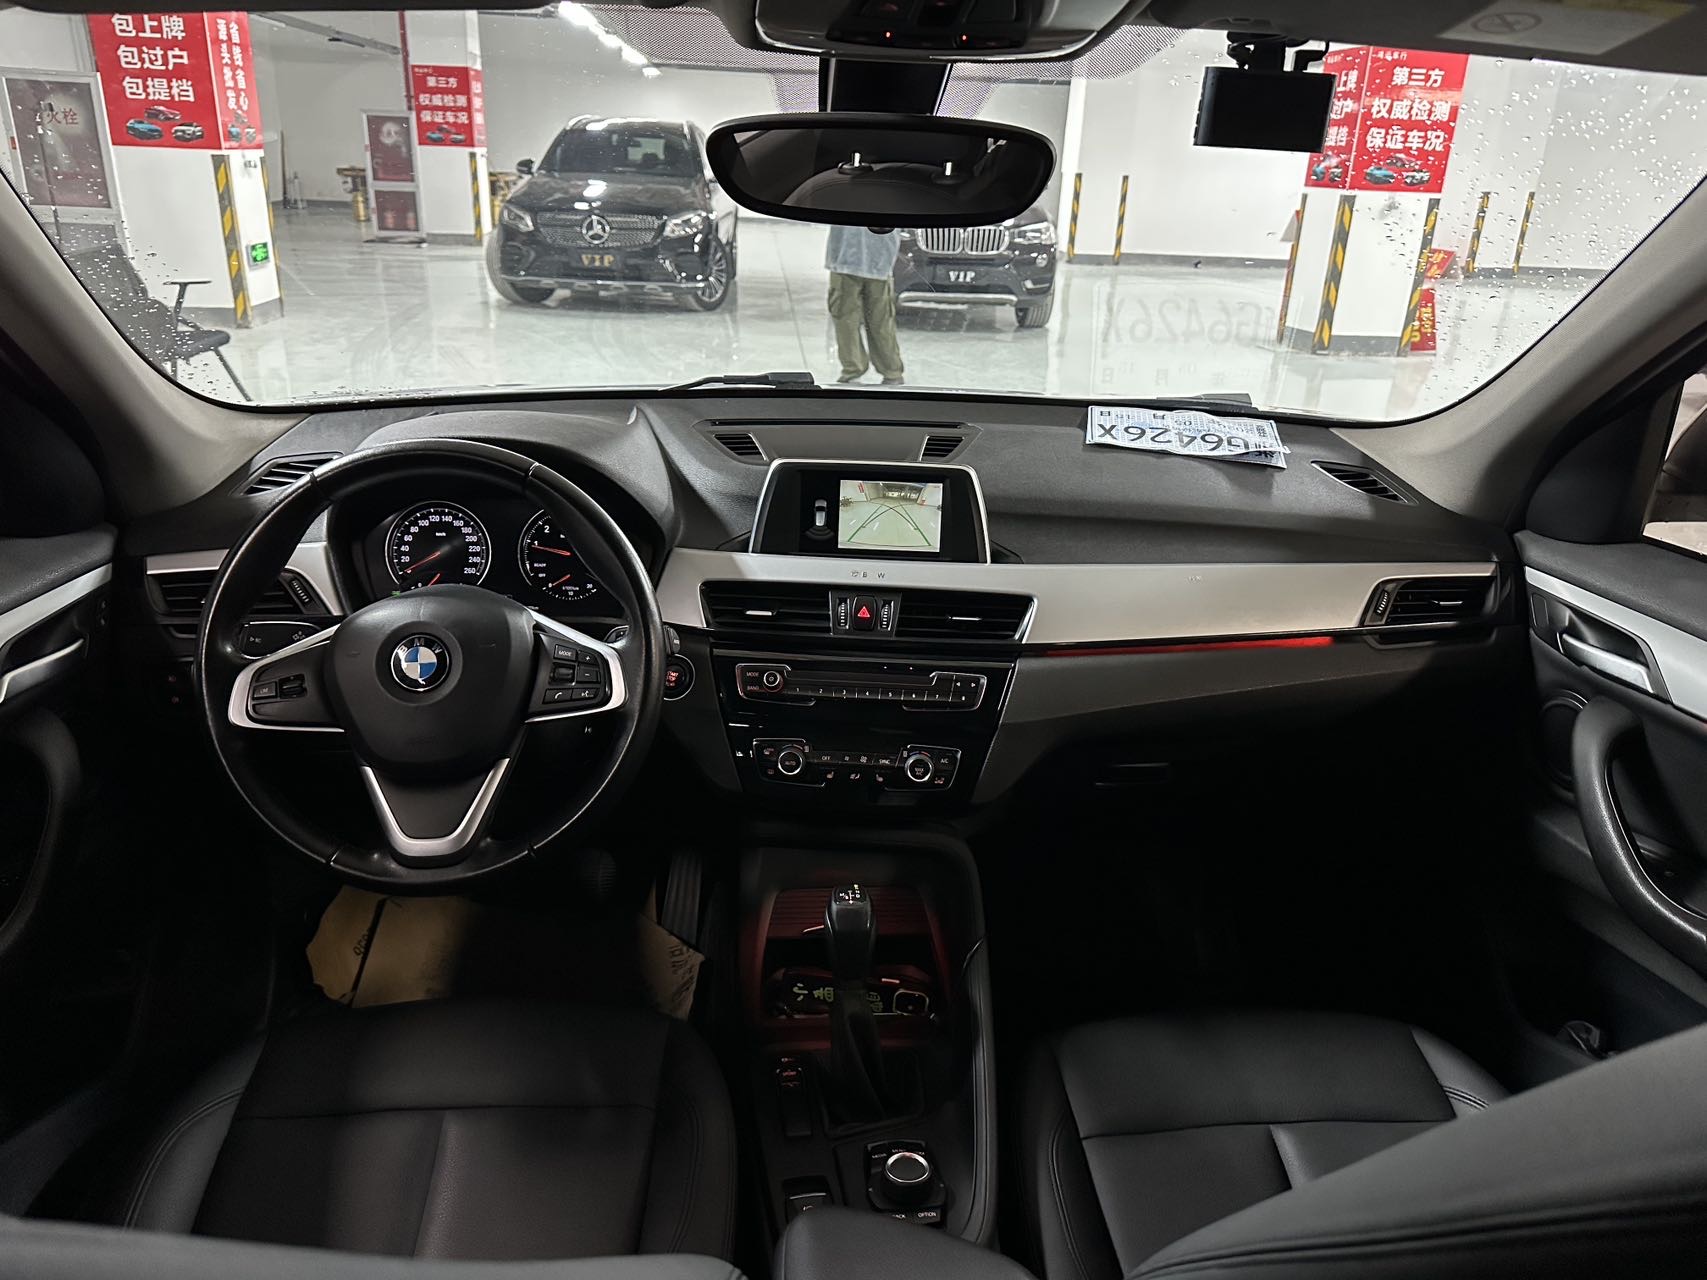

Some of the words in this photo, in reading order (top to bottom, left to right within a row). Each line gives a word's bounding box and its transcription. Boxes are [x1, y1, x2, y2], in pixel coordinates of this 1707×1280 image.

[111, 13, 186, 40] 包上牌
[117, 45, 189, 72] 包过户
[426, 76, 458, 89] 第三方
[1391, 66, 1445, 88] 第三方
[122, 76, 195, 103] 包提档
[1371, 97, 1451, 122] 权威检测
[1366, 126, 1447, 152] 保证车况
[580, 253, 615, 267] VIP
[948, 270, 976, 282] VIP
[543, 525, 550, 533] 2
[397, 638, 443, 655] BMW
